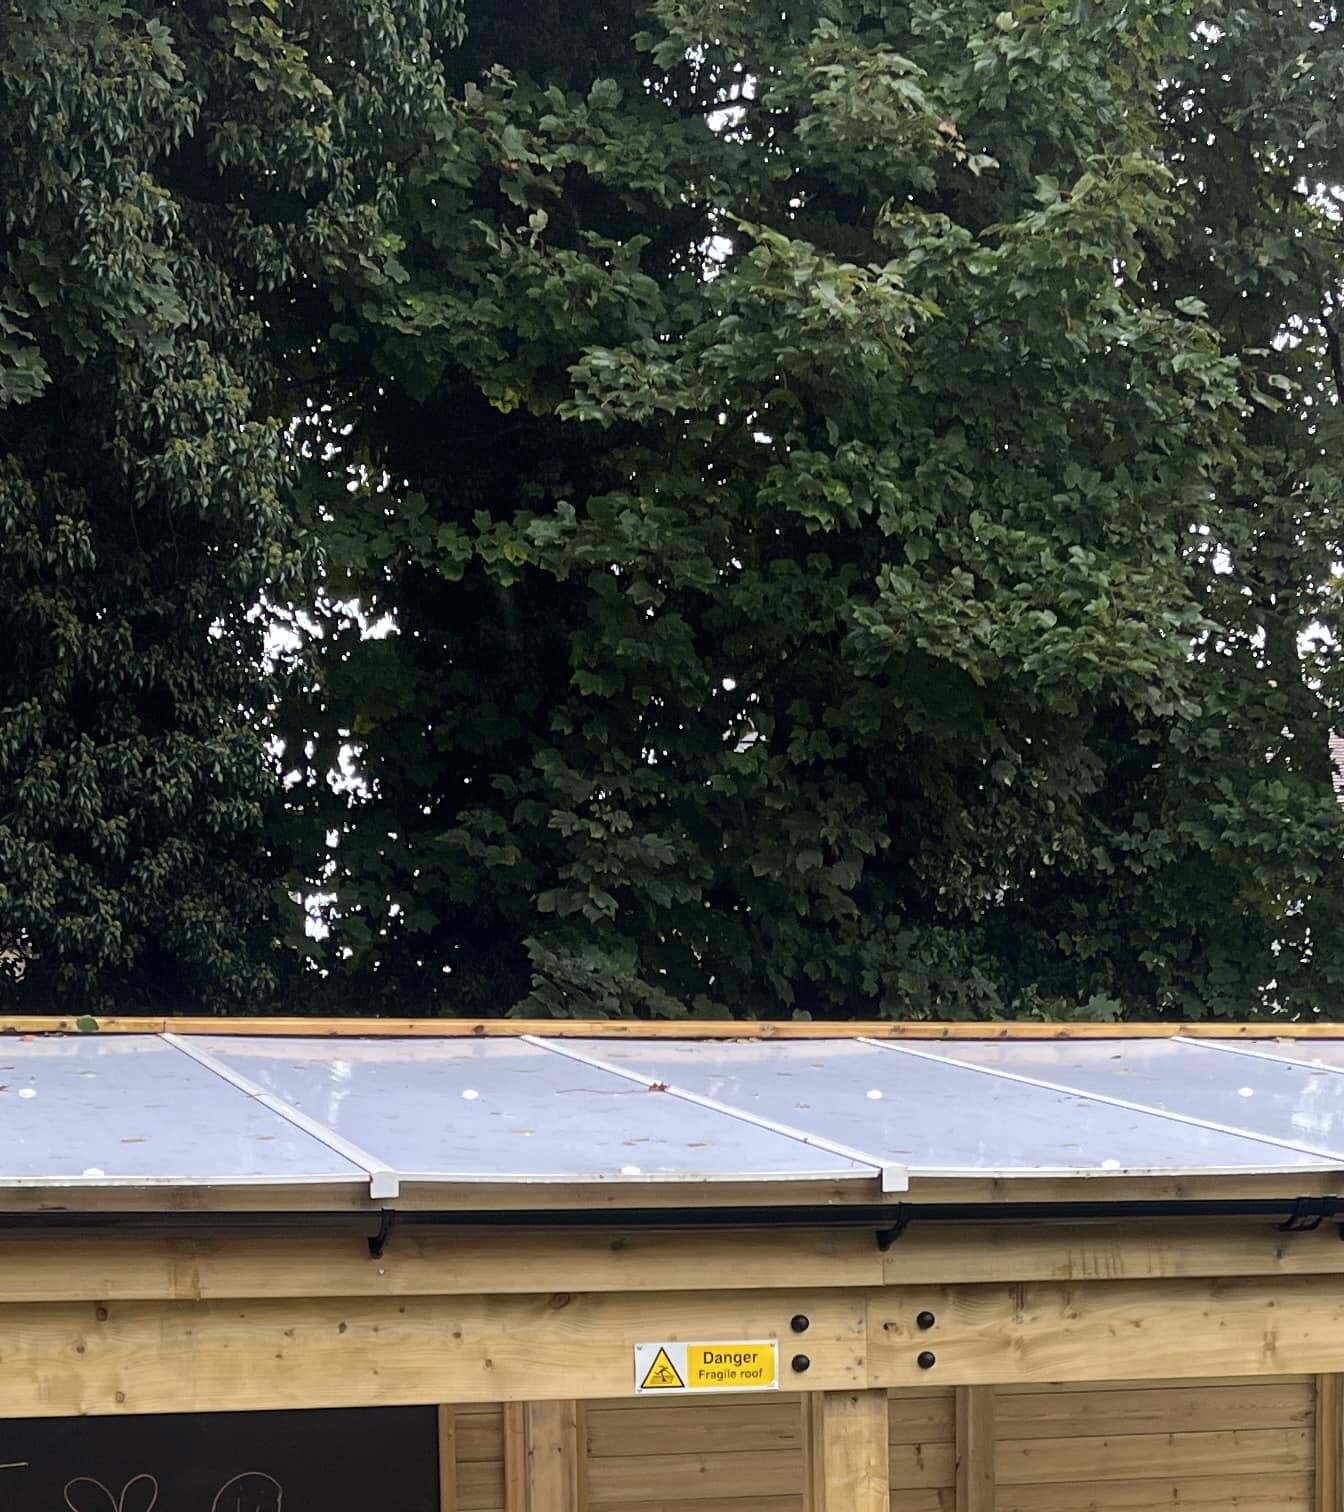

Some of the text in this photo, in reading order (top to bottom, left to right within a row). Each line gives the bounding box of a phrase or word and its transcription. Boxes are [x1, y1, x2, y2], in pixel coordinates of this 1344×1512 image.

[703, 1351, 758, 1367] Danger
[699, 1367, 763, 1381] Fragile roof
